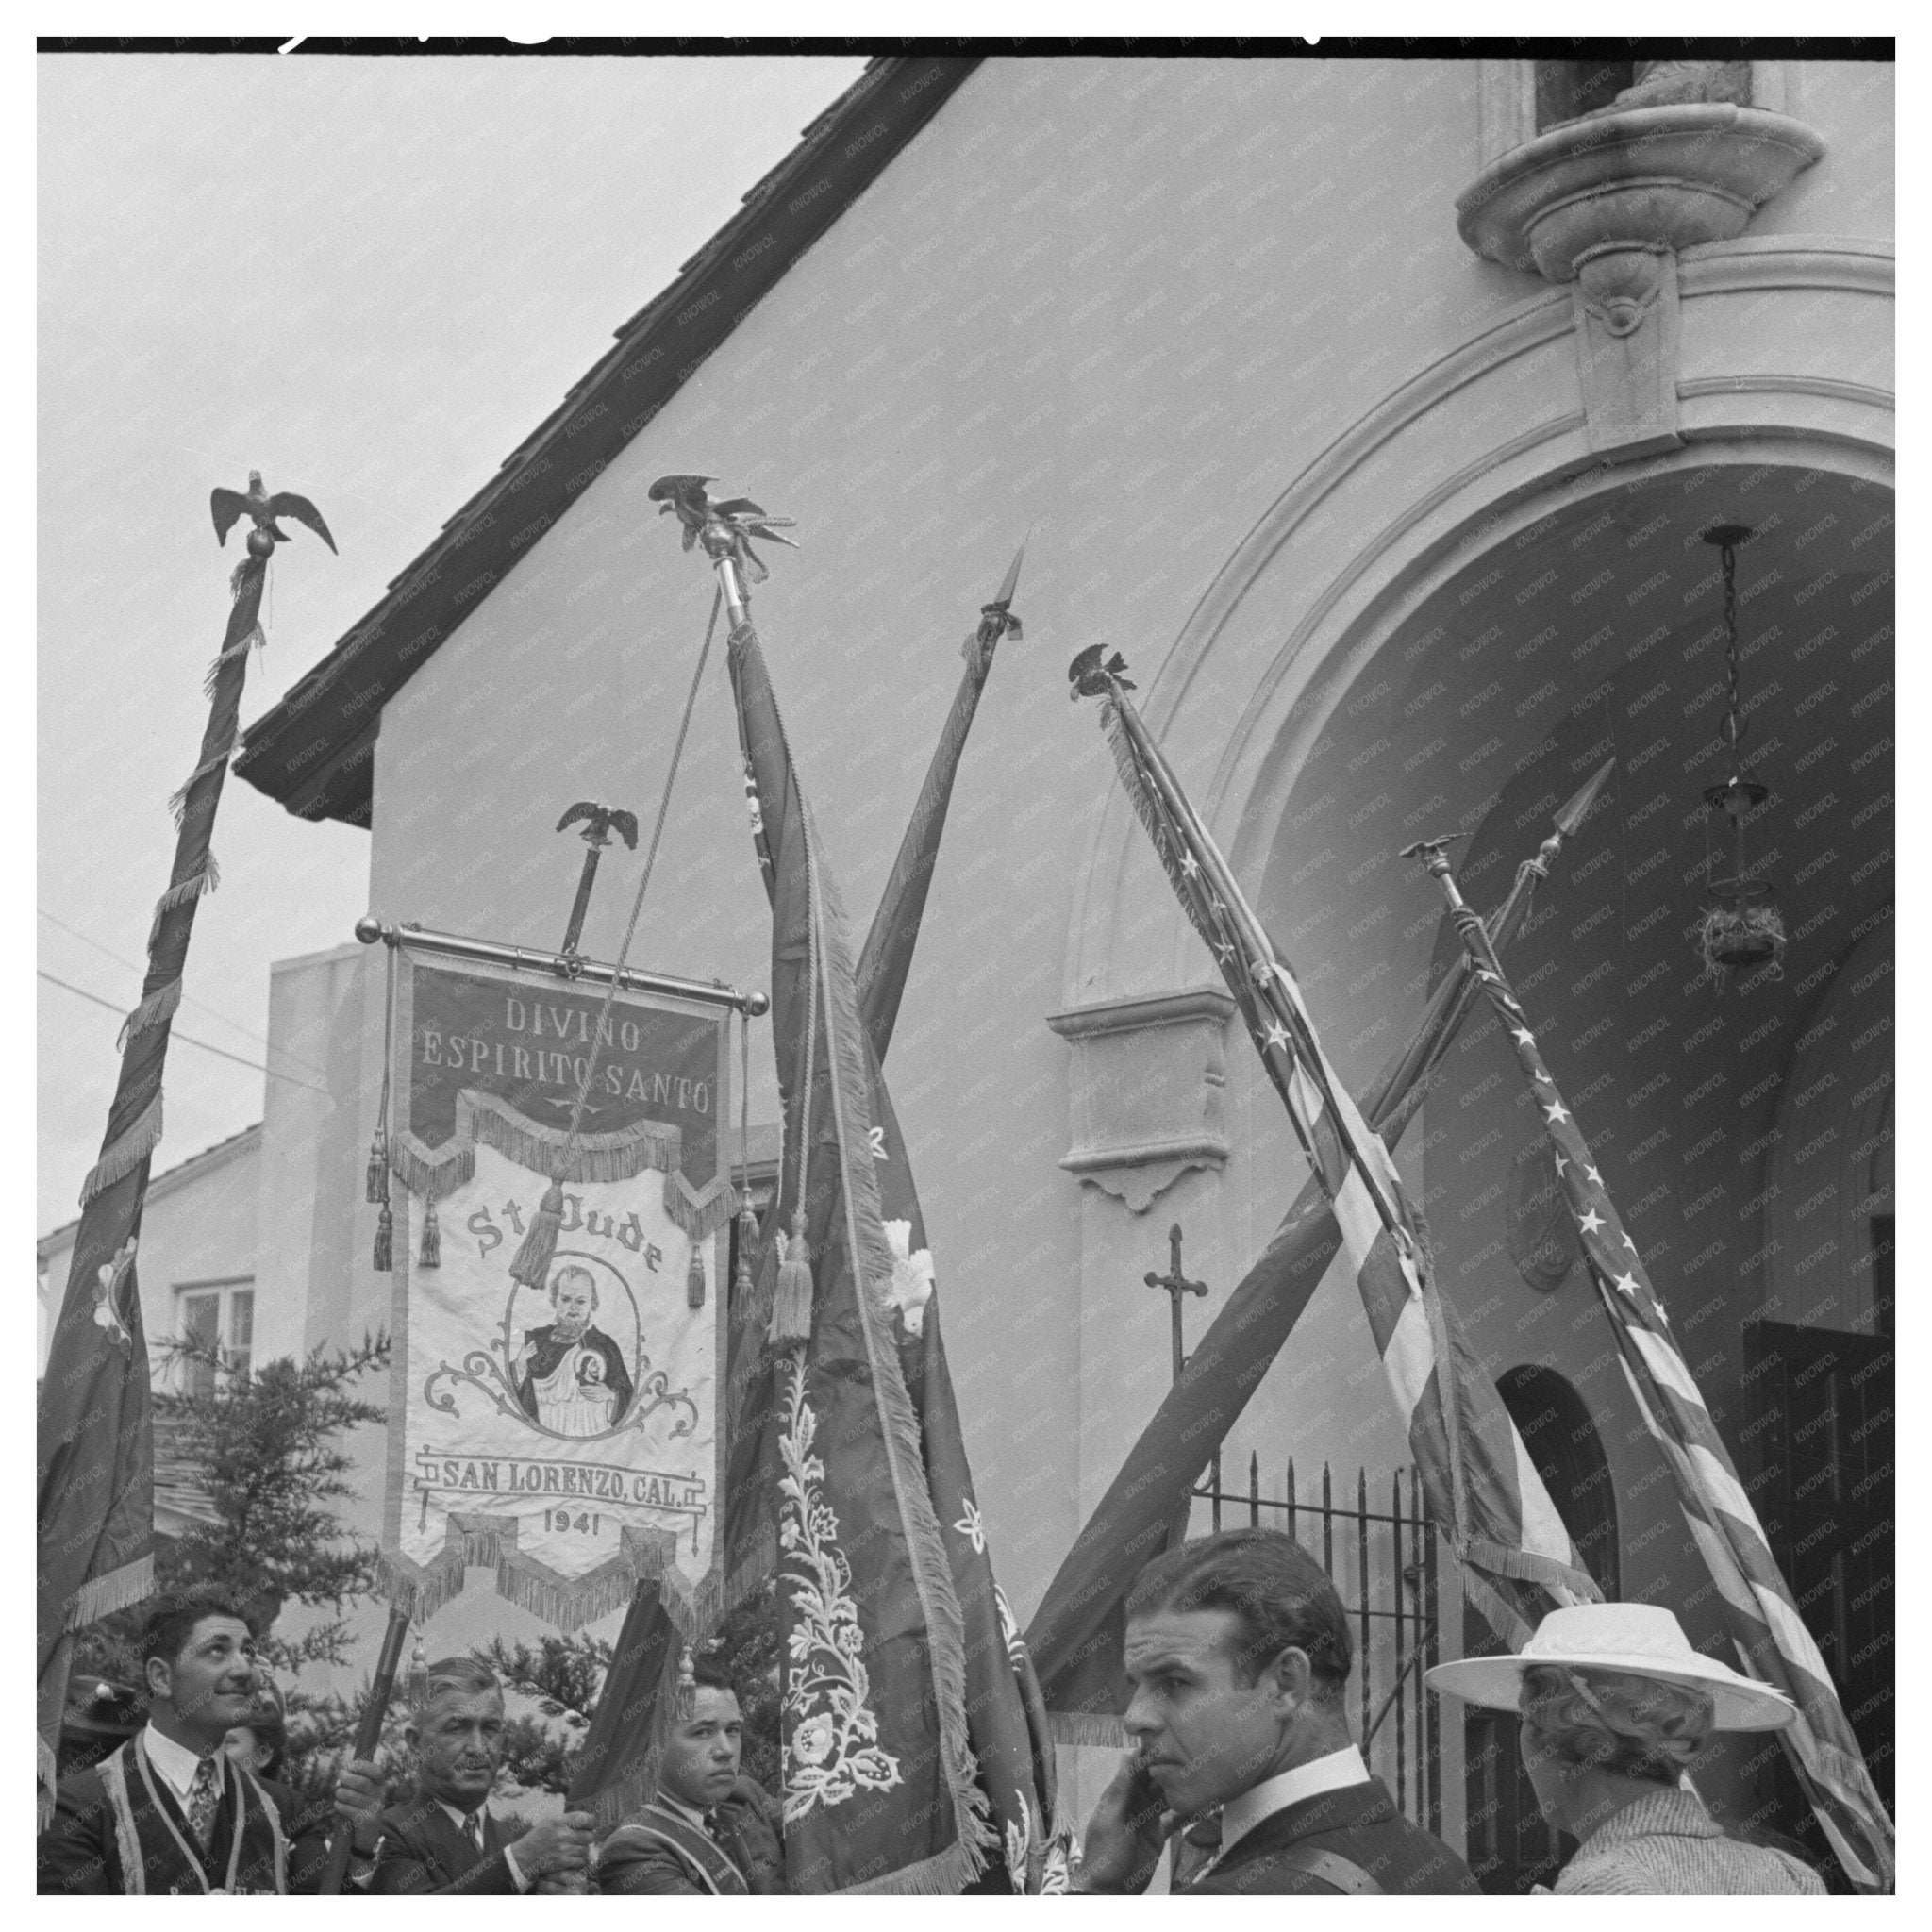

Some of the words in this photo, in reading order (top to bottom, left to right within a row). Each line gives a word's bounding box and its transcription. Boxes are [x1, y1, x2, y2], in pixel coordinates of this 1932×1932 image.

[506, 997, 640, 1052] DIVINO
[423, 1030, 591, 1087] ESPIRITO
[605, 1065, 709, 1113] SANTO
[467, 1198, 526, 1259] St
[559, 1192, 662, 1274] Jude
[442, 1460, 500, 1491] SAN
[508, 1462, 628, 1501] LORENZO,
[632, 1475, 683, 1508] CAL.
[543, 1509, 600, 1536] 1941
